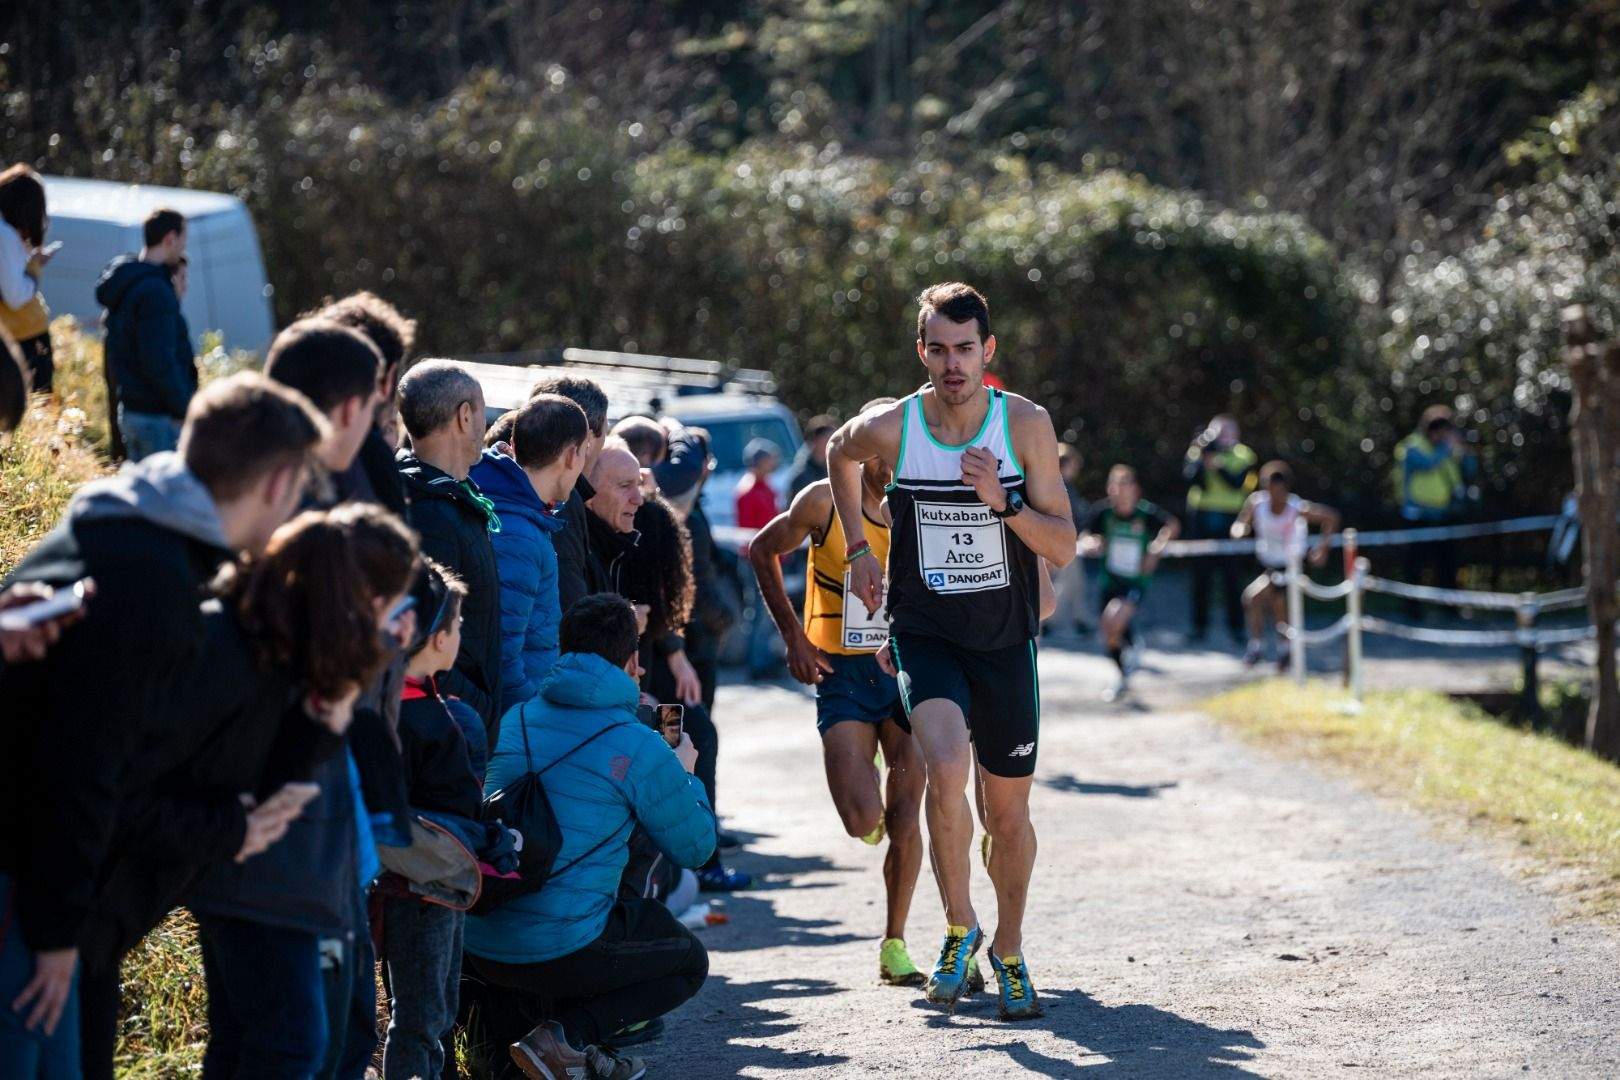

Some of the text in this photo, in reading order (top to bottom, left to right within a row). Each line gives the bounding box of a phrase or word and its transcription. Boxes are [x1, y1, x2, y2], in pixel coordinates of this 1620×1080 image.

[951, 533, 974, 545] 13
[945, 549, 984, 564] Arce
[947, 569, 1003, 584] DANOBAT
[865, 633, 888, 641] DAN
